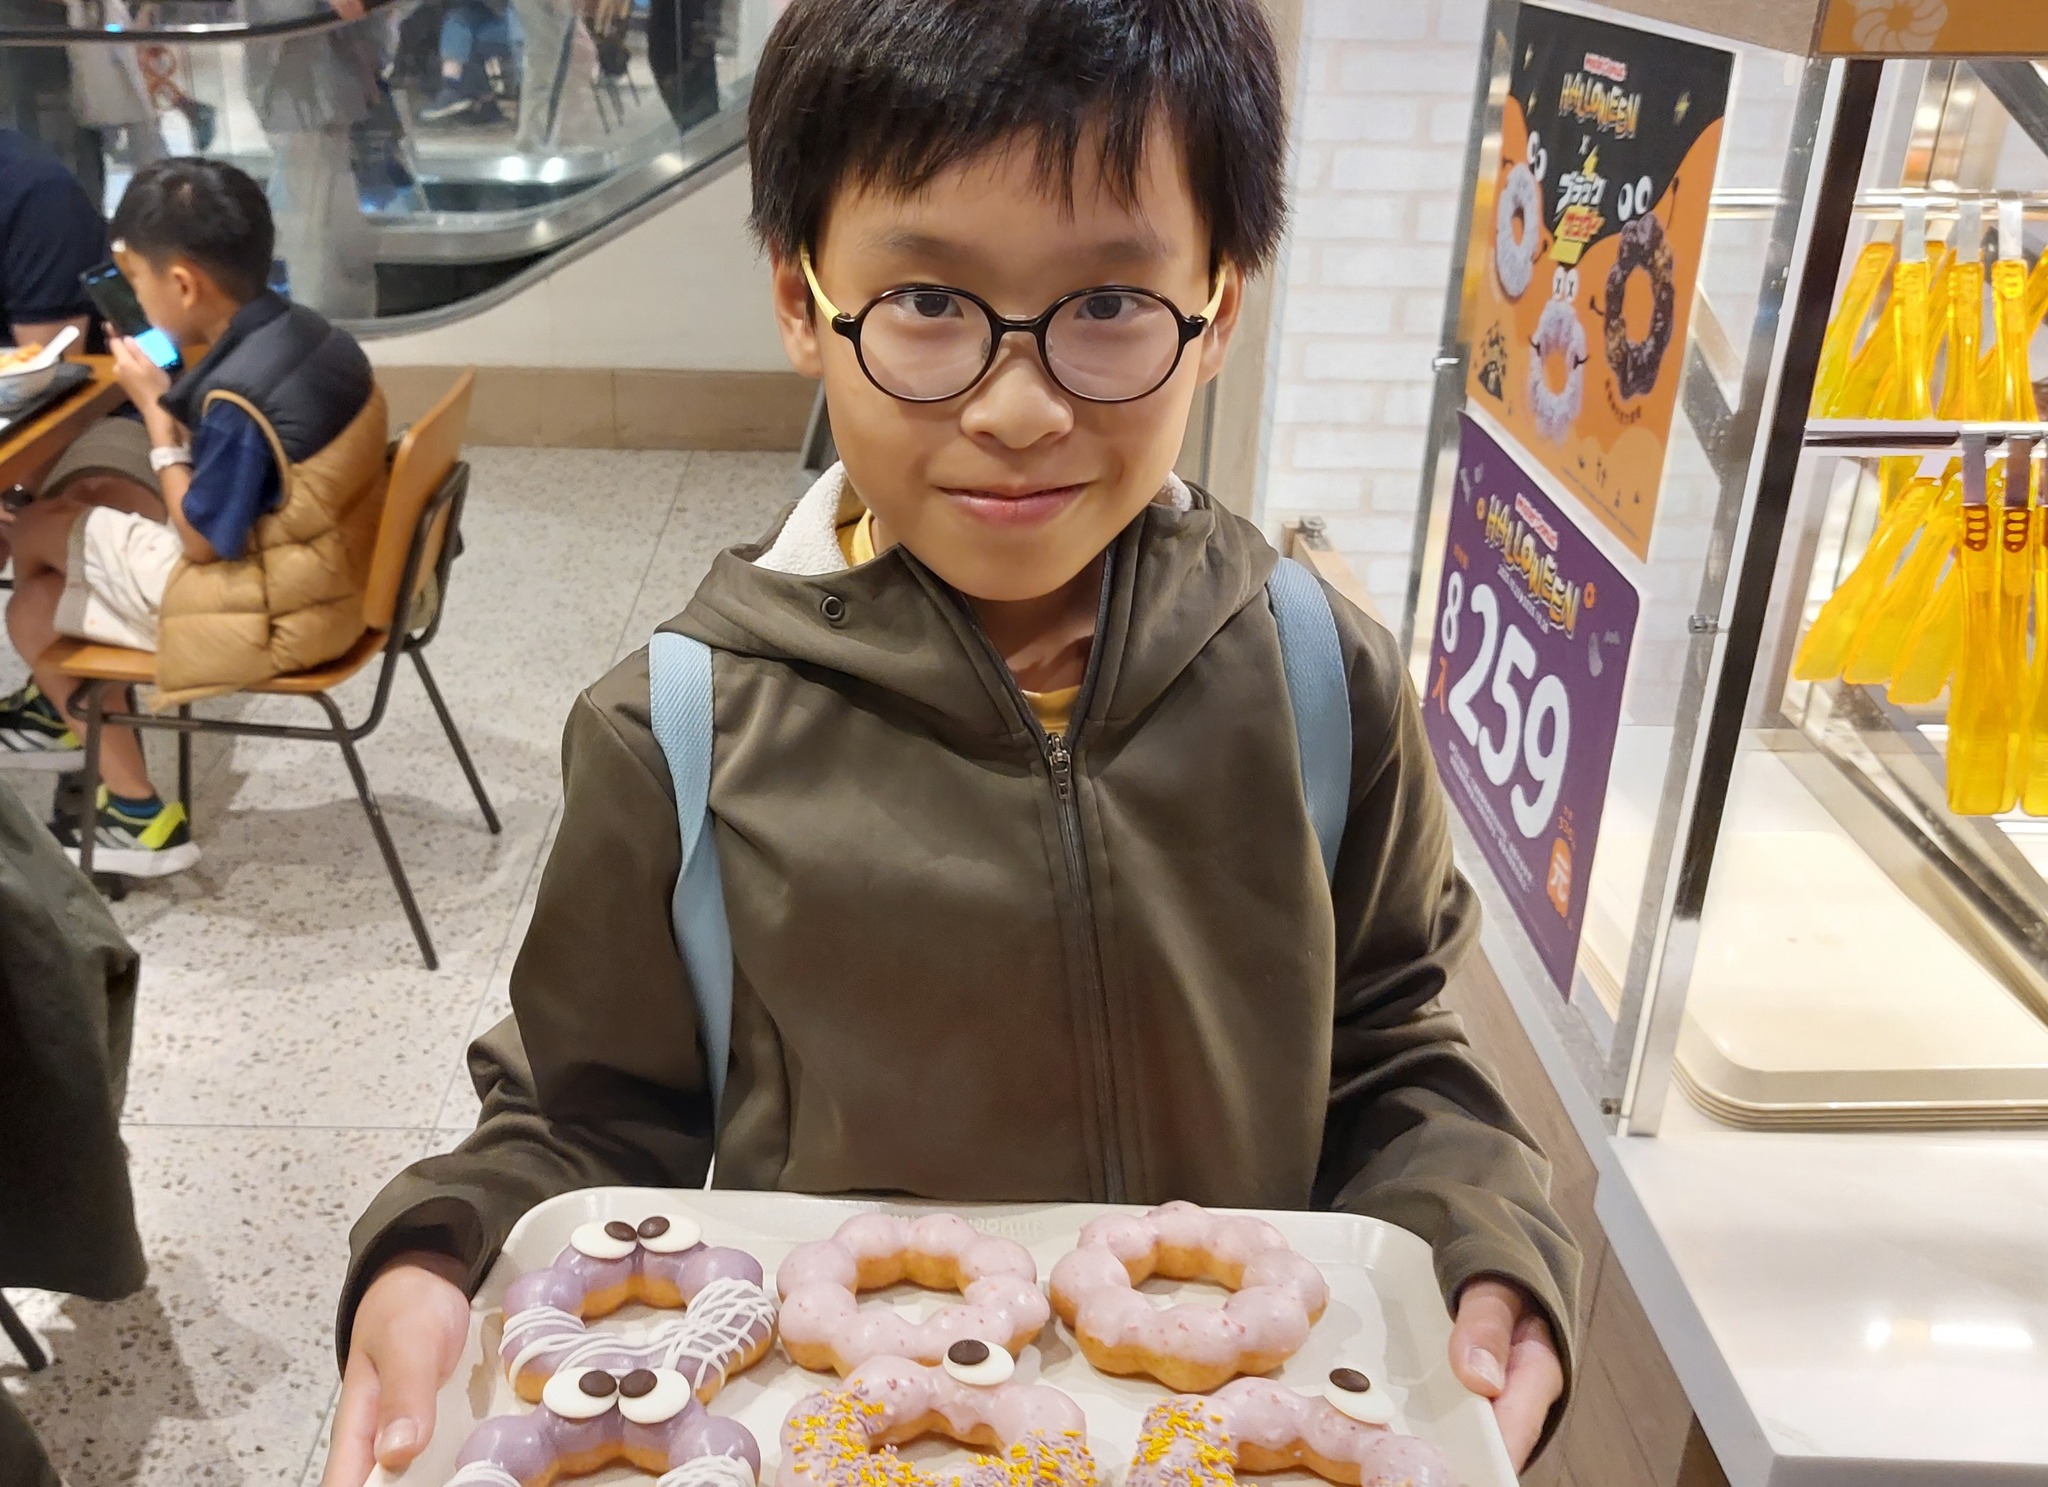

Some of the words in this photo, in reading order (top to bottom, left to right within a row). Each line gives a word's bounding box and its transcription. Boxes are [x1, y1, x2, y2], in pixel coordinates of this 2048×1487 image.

[1558, 72, 1641, 139] HALLOWEEN
[1484, 494, 1581, 640] HALLOWEEN
[1441, 570, 1464, 653] 8
[1448, 583, 1570, 838] 259
[1549, 852, 1569, 902] 元
